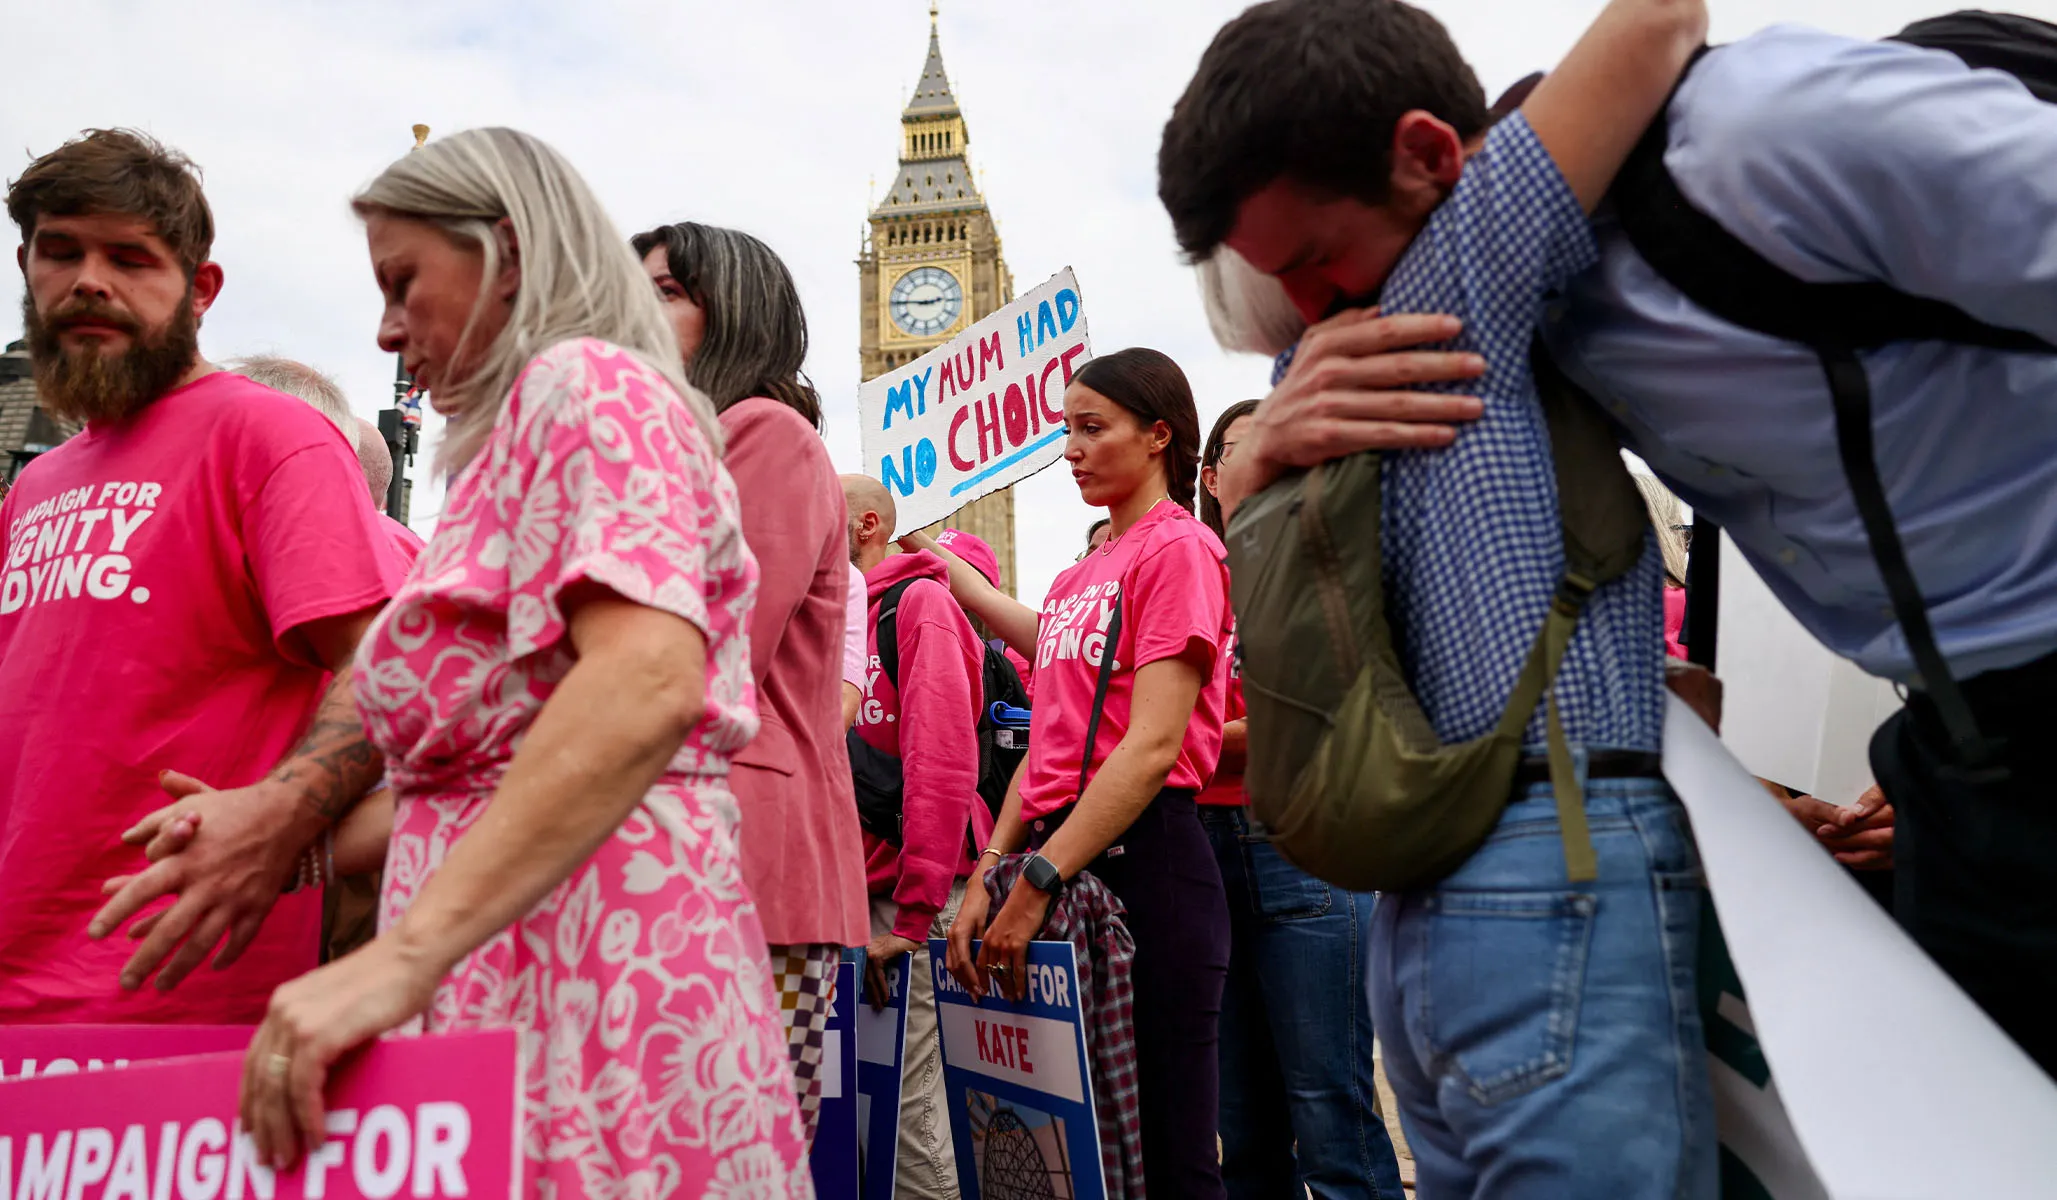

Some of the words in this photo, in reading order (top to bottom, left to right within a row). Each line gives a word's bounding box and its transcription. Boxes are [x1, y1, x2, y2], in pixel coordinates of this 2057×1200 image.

[882, 366, 933, 431] MY
[938, 330, 1004, 404] MUM
[1016, 288, 1079, 358] HAD
[97, 481, 163, 507] FOR
[881, 437, 937, 497] NO
[0, 553, 150, 615] DYING.
[1026, 963, 1072, 1008] FOR
[975, 1019, 1034, 1074] KATE
[303, 1100, 472, 1200] FOR
